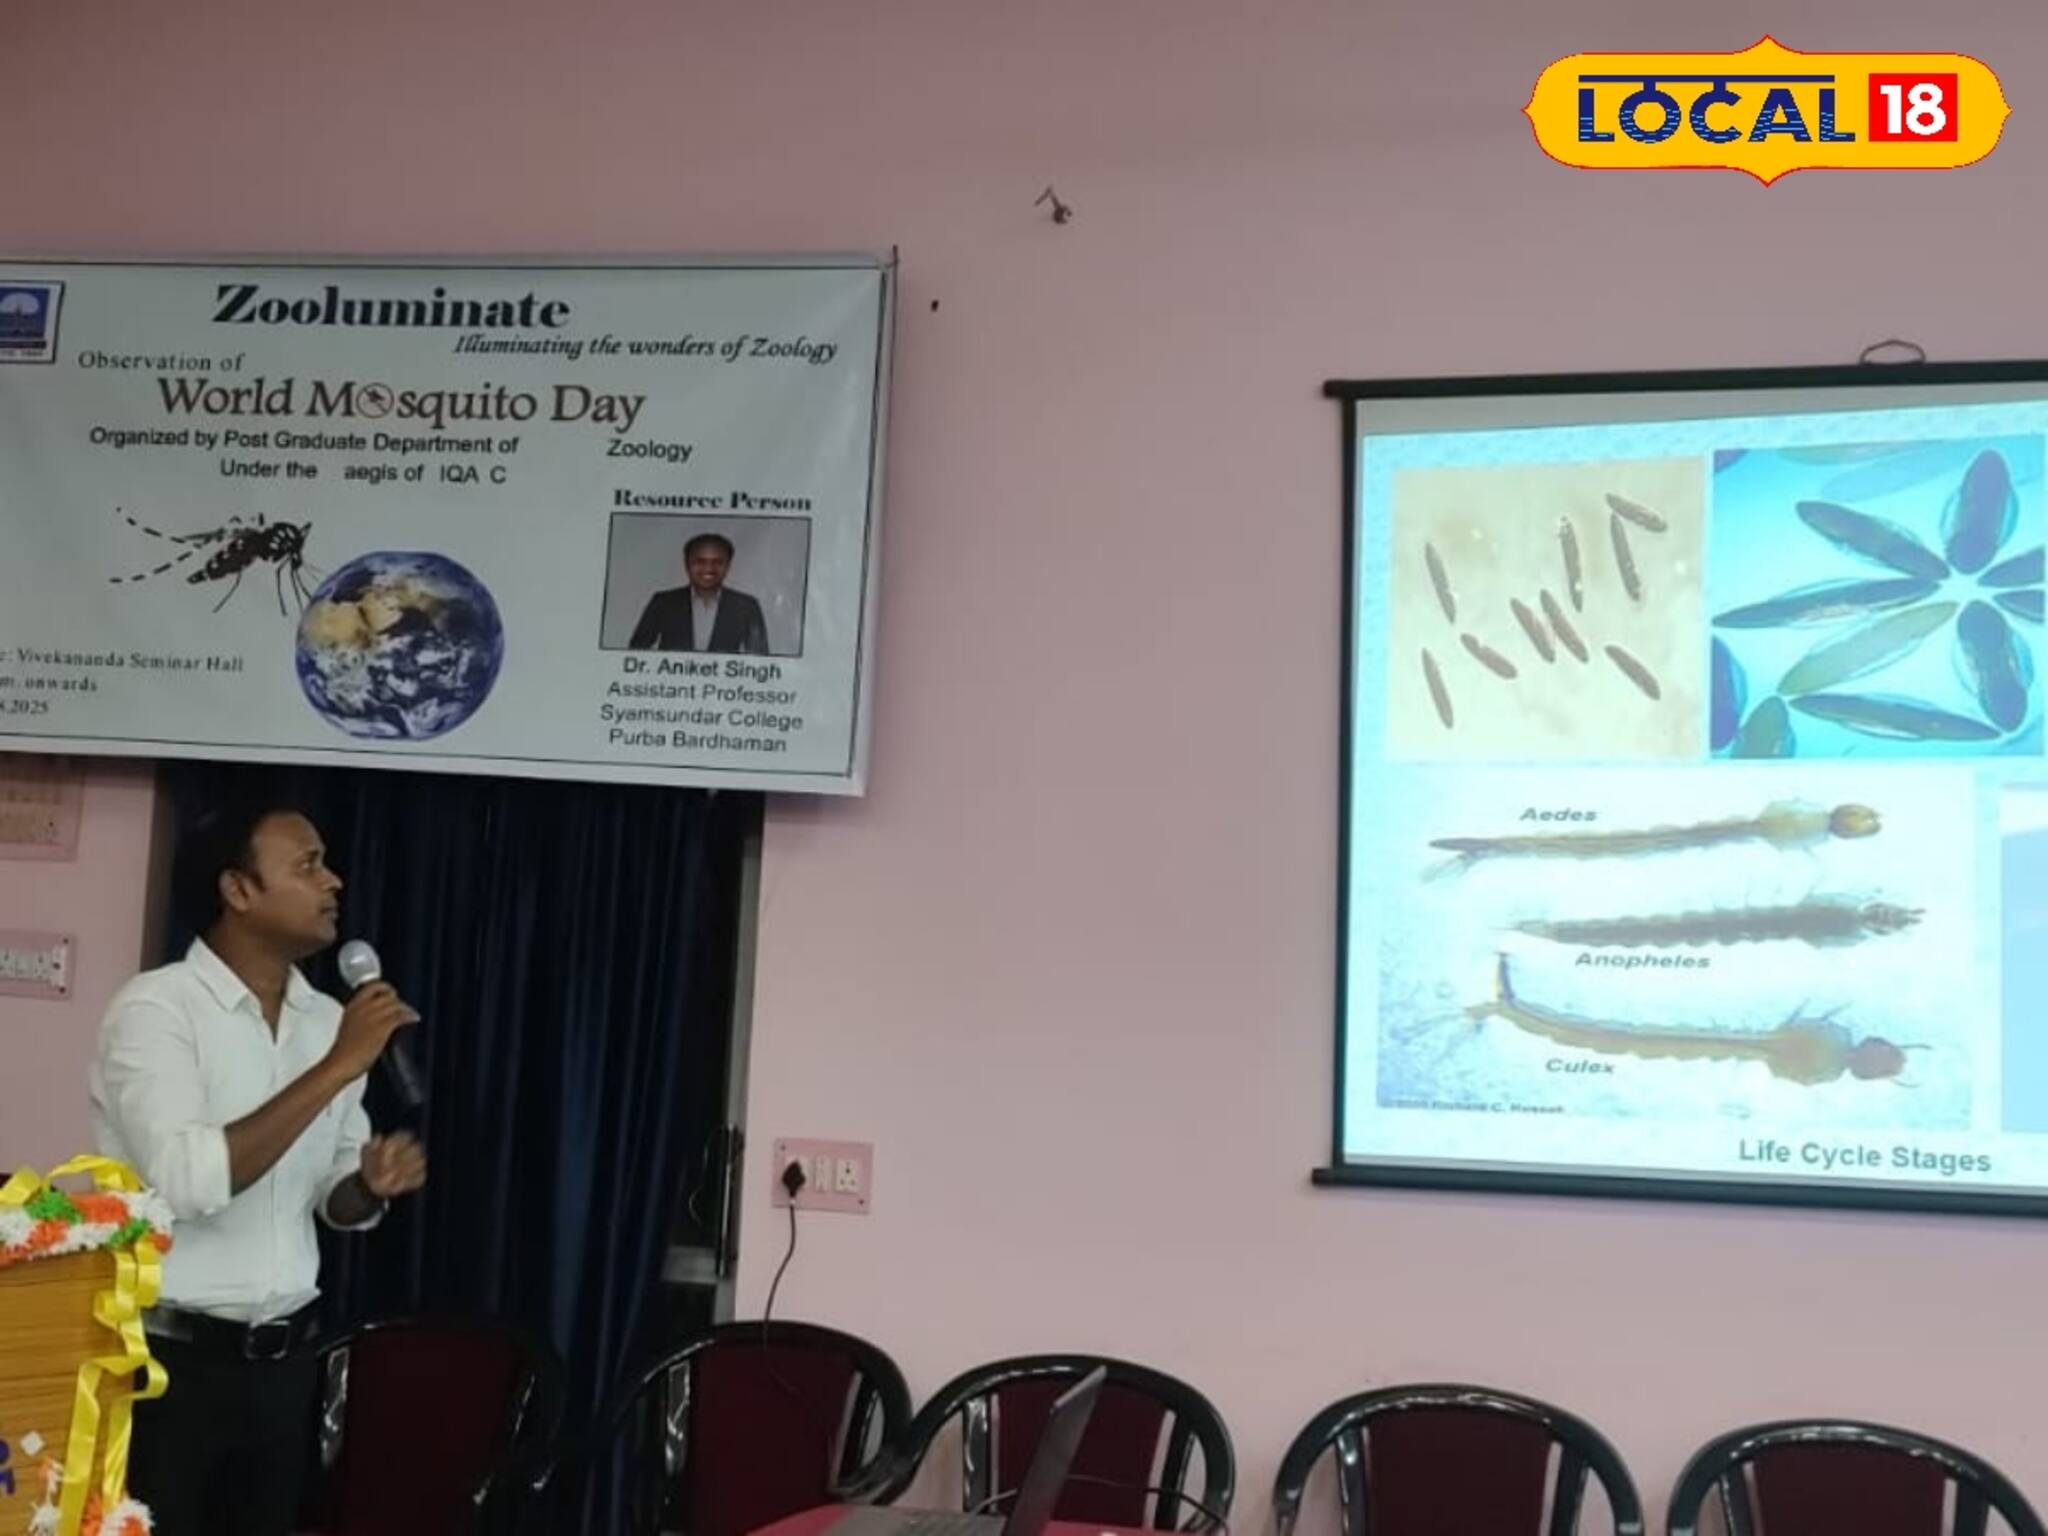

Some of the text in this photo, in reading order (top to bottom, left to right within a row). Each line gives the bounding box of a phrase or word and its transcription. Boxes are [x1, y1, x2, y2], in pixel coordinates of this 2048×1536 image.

[212, 284, 570, 328] Zooluminate
[78, 350, 246, 372] Observation of
[454, 334, 838, 364] Illuminating the wonders of Zoology
[158, 377, 295, 415] World
[551, 385, 646, 434] Day
[90, 426, 693, 462] Organized by Post Graduate Department of Zoology
[220, 459, 507, 485] Under the aegis of IQA C
[614, 489, 812, 511] Resource Person
[18, 647, 126, 666] Vivekananda
[129, 653, 200, 670] Seminar
[206, 655, 243, 672] Hall
[623, 657, 781, 683] Dr. Aniket Singh
[24, 677, 98, 692] onwards
[607, 681, 797, 705] Assistant Professor
[600, 704, 804, 732] Syamsundar College
[609, 729, 787, 751] Purba Bardhaman
[1519, 806, 1598, 824] Aedes
[1574, 951, 1712, 970] Anopheles
[1545, 1059, 1615, 1076] Culex
[1739, 1138, 1993, 1175] Life Cycle Stages
